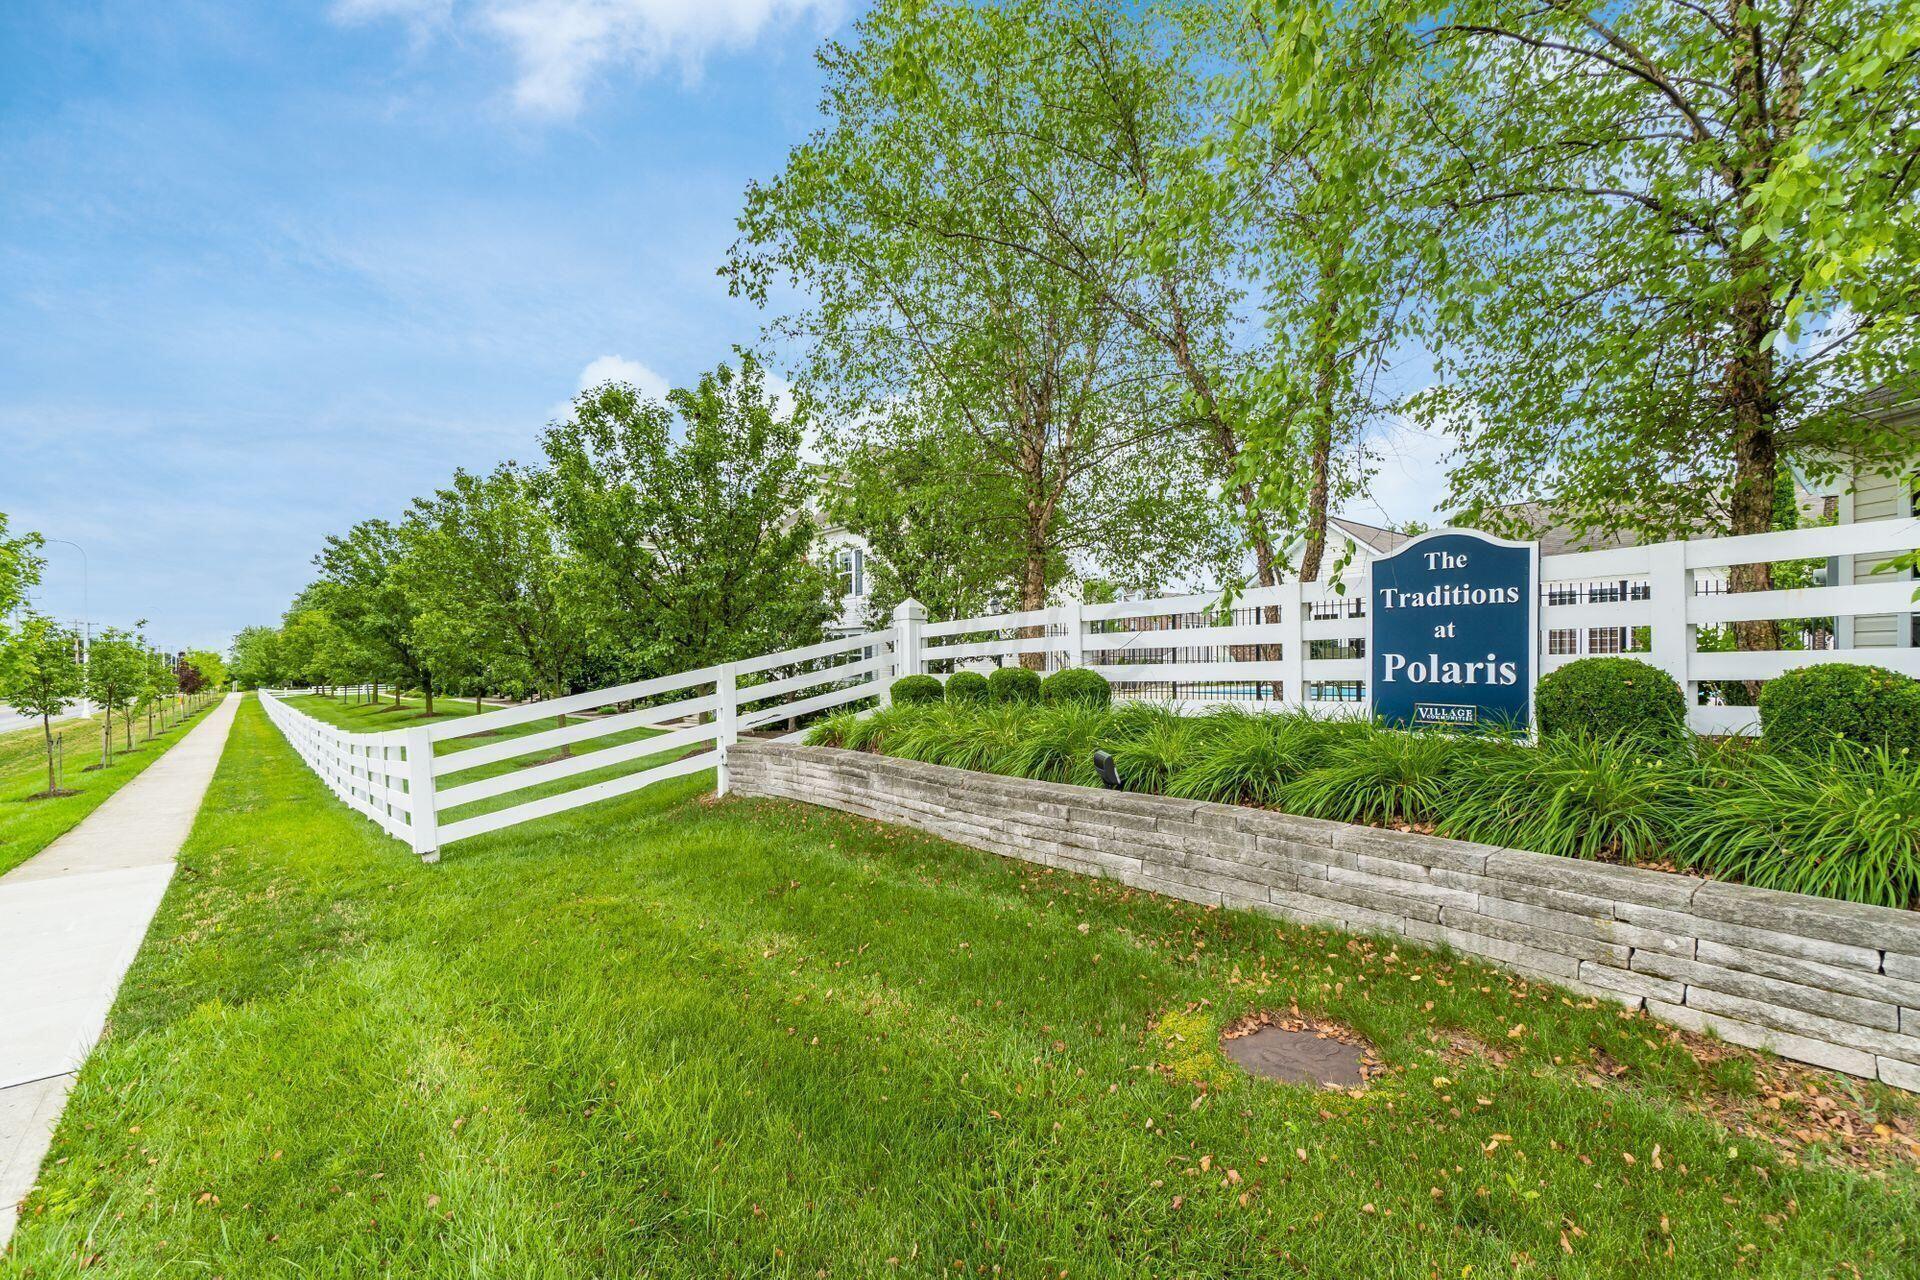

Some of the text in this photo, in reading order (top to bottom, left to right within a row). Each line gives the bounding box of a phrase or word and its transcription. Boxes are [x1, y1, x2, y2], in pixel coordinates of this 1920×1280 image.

[1424, 551, 1468, 571] The
[1380, 583, 1520, 609] Traditions
[1434, 621, 1456, 639] at
[1382, 653, 1517, 686] Polaris
[1418, 707, 1473, 719] VILLAGE
